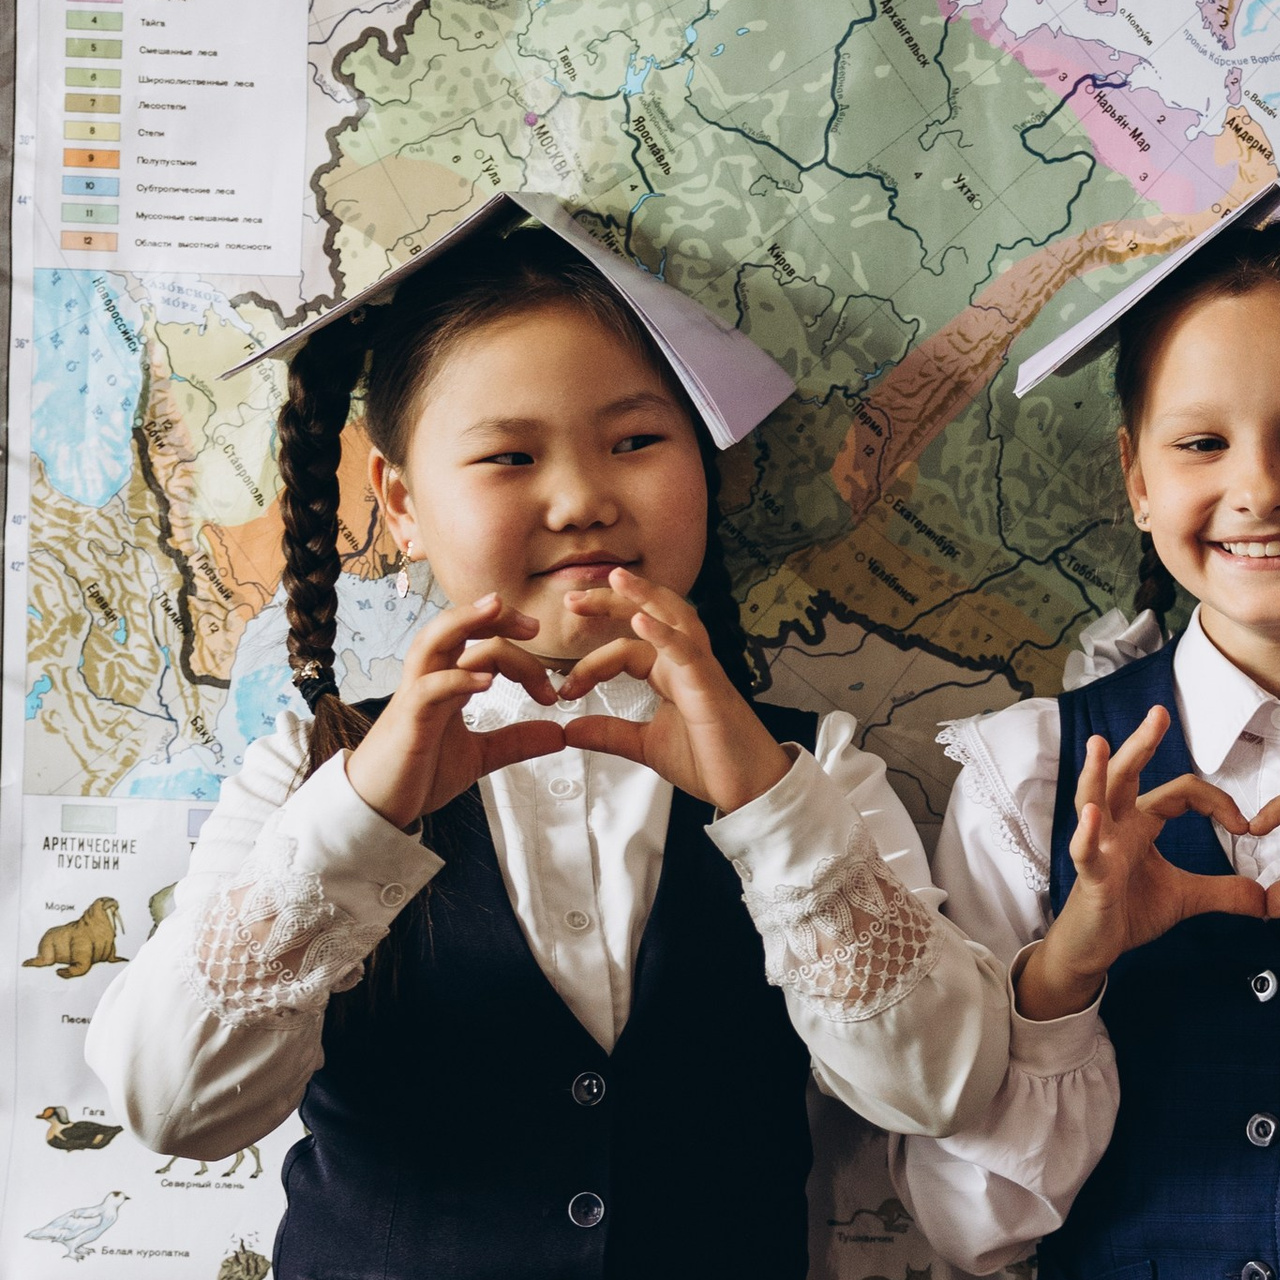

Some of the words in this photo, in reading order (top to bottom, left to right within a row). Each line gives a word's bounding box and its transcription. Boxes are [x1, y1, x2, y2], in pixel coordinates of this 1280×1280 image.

[91, 16, 98, 24] 4
[90, 44, 97, 52] 5
[555, 45, 579, 83] Тверь
[88, 154, 94, 162] 9
[85, 181, 94, 190] 10
[83, 237, 92, 245] 12
[43, 836, 137, 854] АРКТИЧЕСКИЕ
[57, 854, 120, 870] ПУСТЫНИ
[45, 902, 75, 912] Морж
[82, 1106, 105, 1116] Гага
[161, 1179, 211, 1190] Северный
[101, 1247, 132, 1256] Белая
